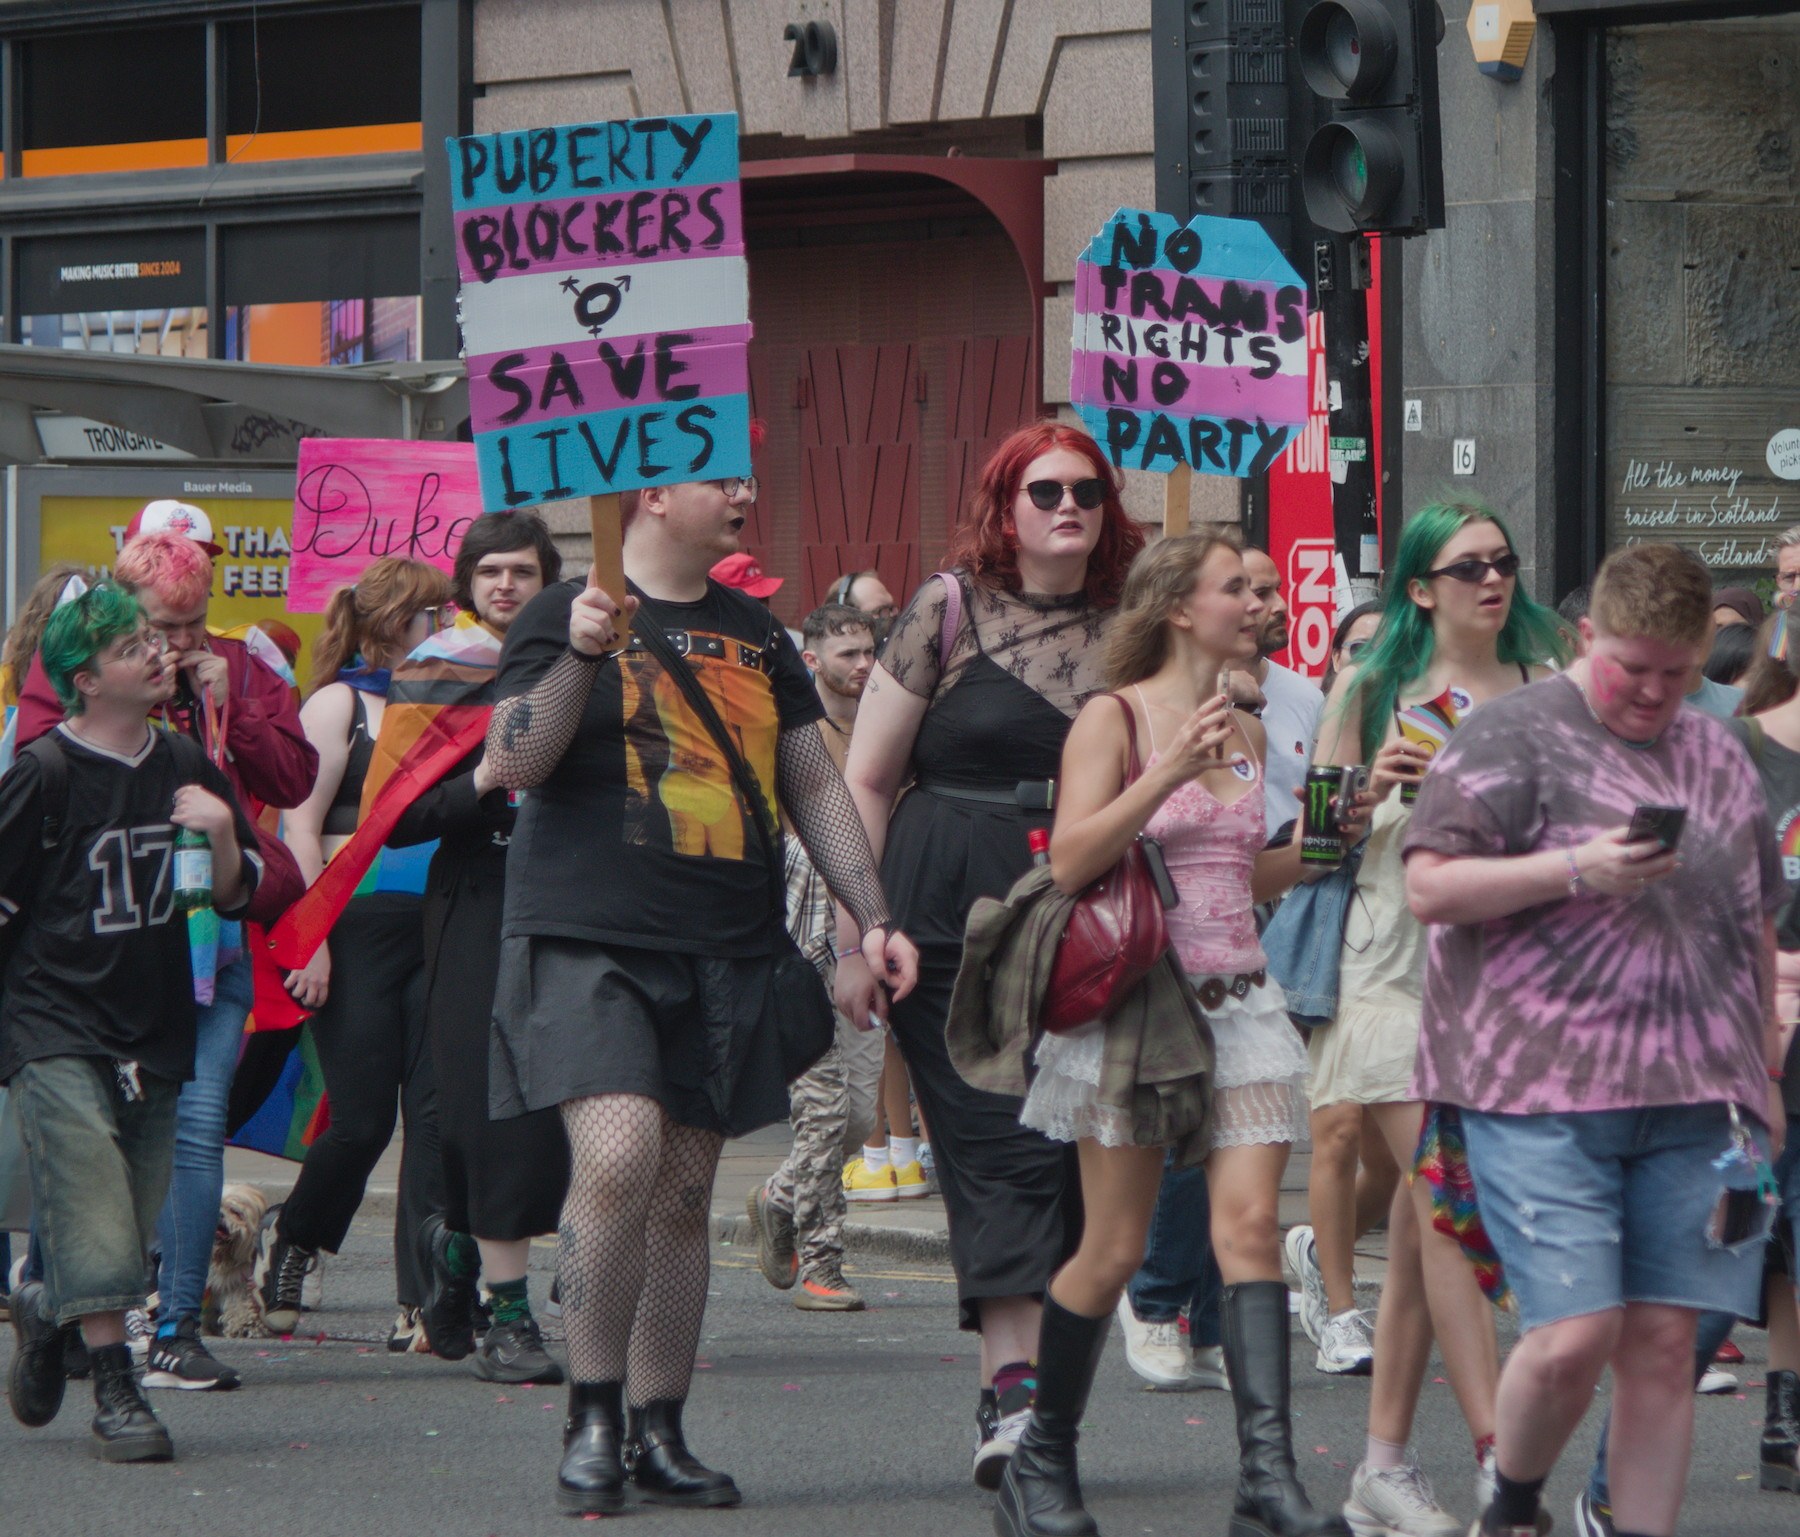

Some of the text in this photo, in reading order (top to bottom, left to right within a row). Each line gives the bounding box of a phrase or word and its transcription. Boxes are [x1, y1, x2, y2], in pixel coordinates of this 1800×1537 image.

[784, 21, 837, 77] 20
[458, 118, 713, 200] PUBERTY
[462, 186, 725, 284] BLOCKERS
[1110, 213, 1203, 275] NO
[60, 260, 181, 281] MAKING MUSIC BETTER SINCE 2004
[1101, 312, 1282, 380] RIGHTS
[487, 333, 706, 425] SAVE
[1103, 355, 1191, 406] NO
[497, 404, 717, 506] LIVES
[1106, 407, 1290, 478] PARTY
[1457, 444, 1471, 469] 16
[1770, 437, 1800, 455] Volunt
[183, 481, 253, 494] Bauer Media
[1622, 459, 1743, 498] All the money
[289, 464, 477, 563] Duke
[1624, 495, 1781, 527] raised in Scotland
[223, 526, 291, 556] THA
[1699, 537, 1768, 566] Scotland
[88, 824, 176, 933] 17
